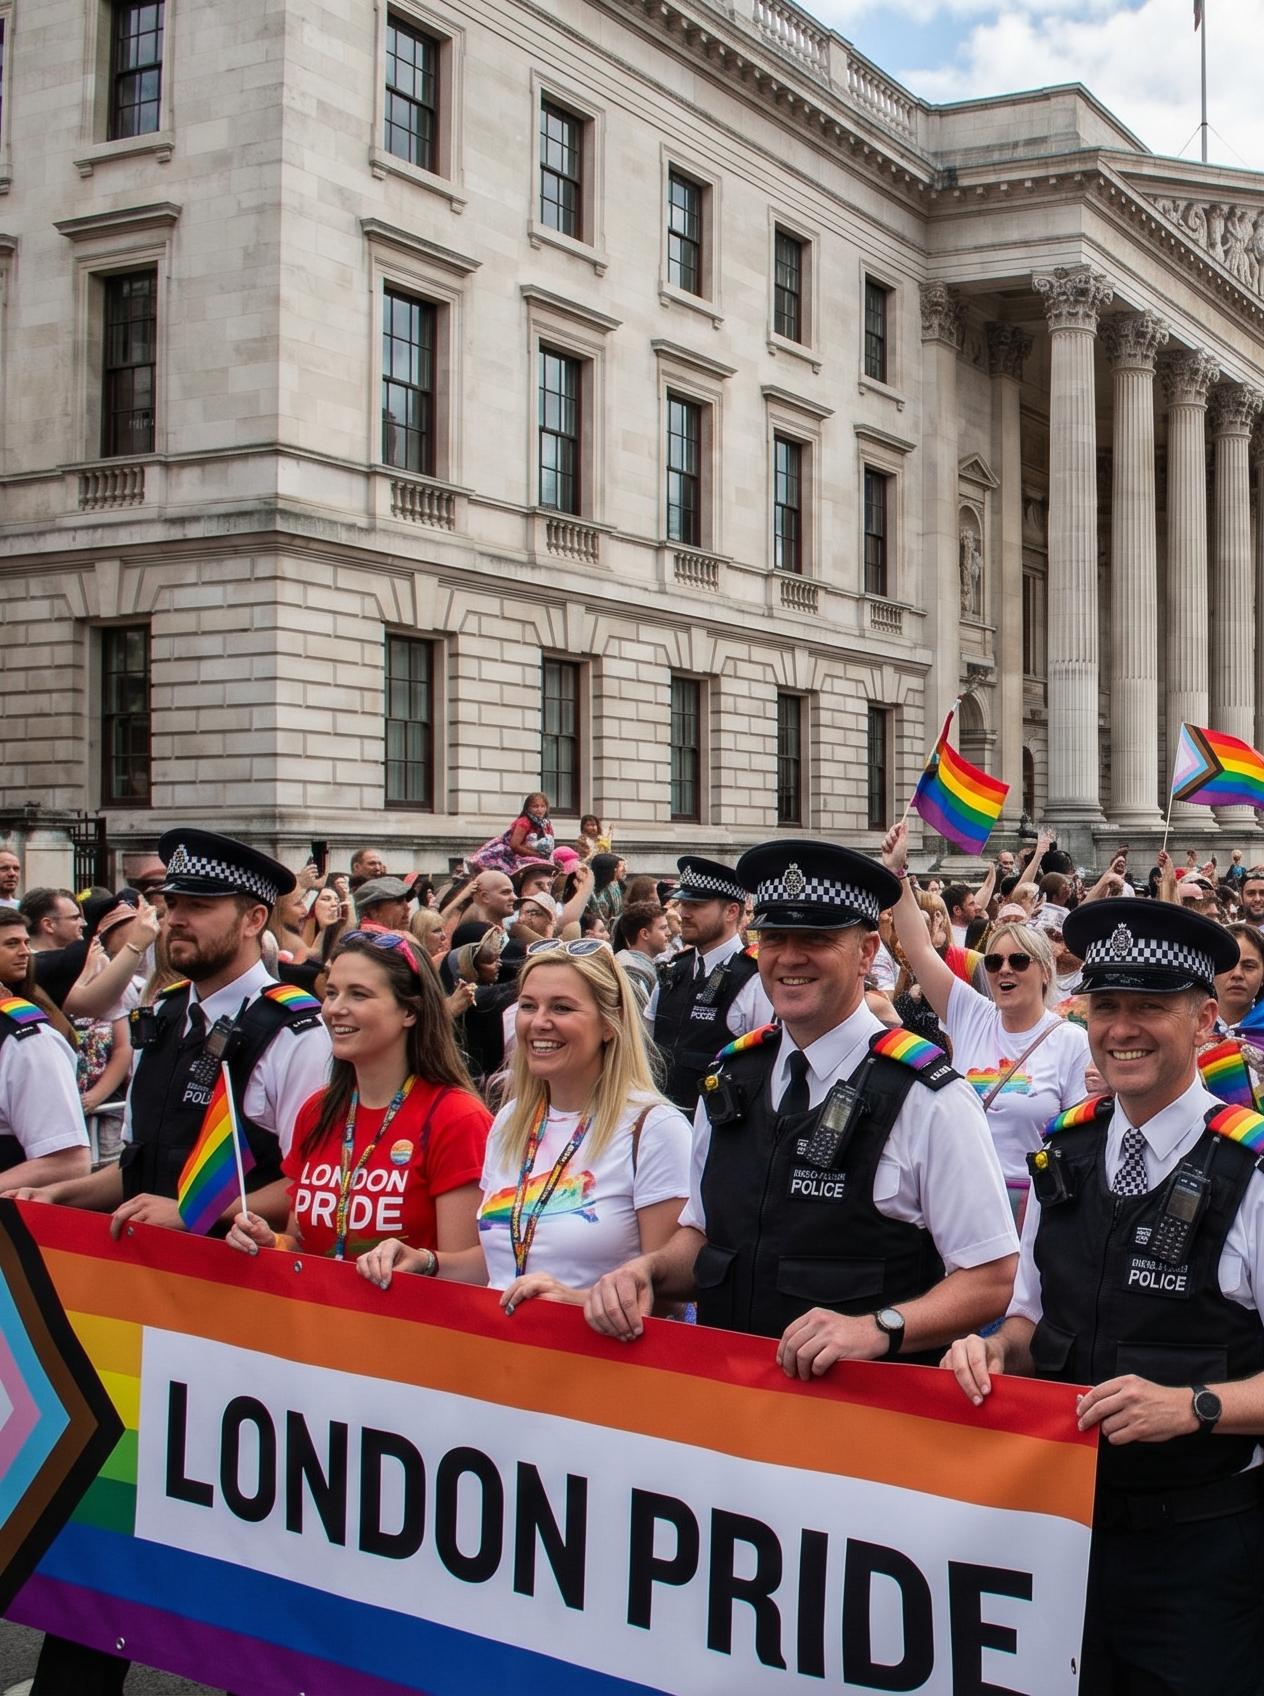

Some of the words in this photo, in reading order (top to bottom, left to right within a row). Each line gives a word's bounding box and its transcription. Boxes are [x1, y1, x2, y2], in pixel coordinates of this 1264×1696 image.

[790, 1179, 845, 1198] POLICE
[294, 1188, 404, 1231] PRDE
[1128, 1269, 1187, 1291] POLICE
[164, 1380, 589, 1612] LONDON
[626, 1487, 1034, 1696] PRIDE
